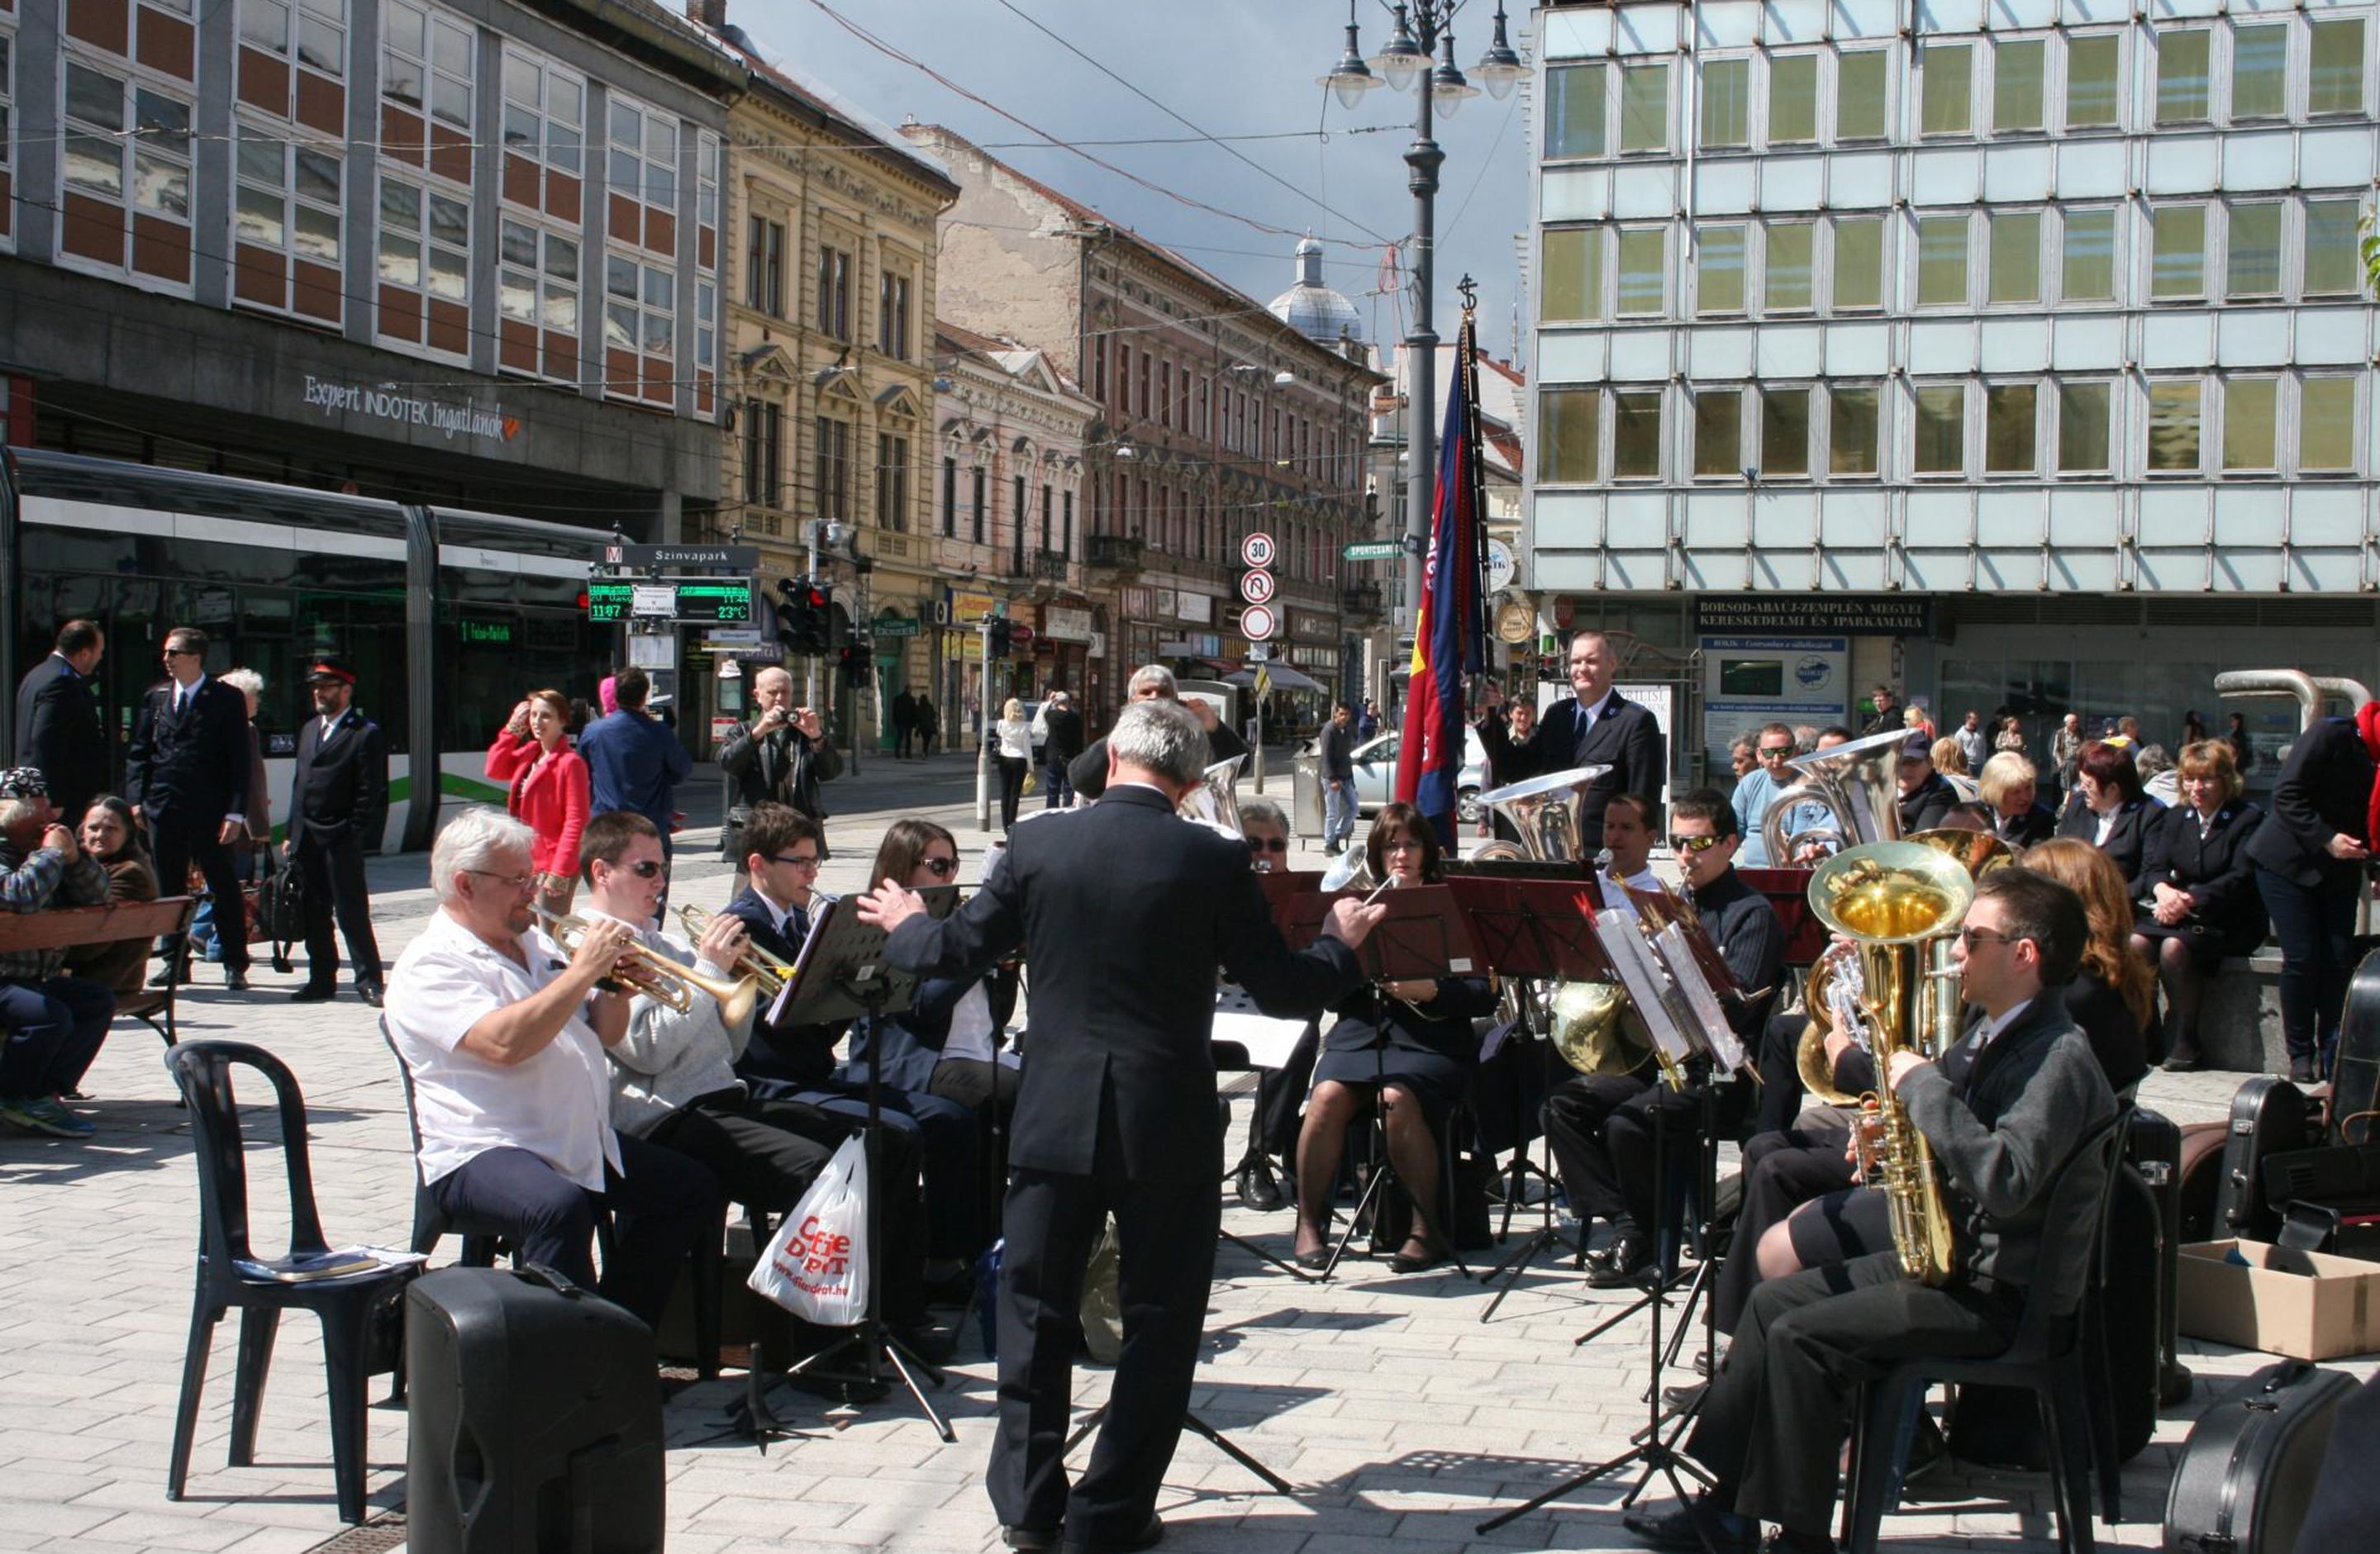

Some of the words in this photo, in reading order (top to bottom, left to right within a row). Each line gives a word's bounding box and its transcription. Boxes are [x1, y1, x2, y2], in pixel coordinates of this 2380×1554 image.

[303, 375, 360, 416] Expert
[364, 392, 428, 425] INDOTEK
[432, 397, 504, 442] Ingatlanok
[655, 551, 728, 563] Szinvapark
[1251, 543, 1266, 558] 30
[718, 606, 747, 619] 23°C
[1700, 601, 1864, 613] BORSOD-ABAÚJ-ZEMPLÉN
[1870, 602, 1922, 614] MEGYEI
[1700, 615, 1805, 626] KERESKEDELMI
[1811, 614, 1828, 626] ÉS
[1835, 615, 1923, 627] IPARKAMARA
